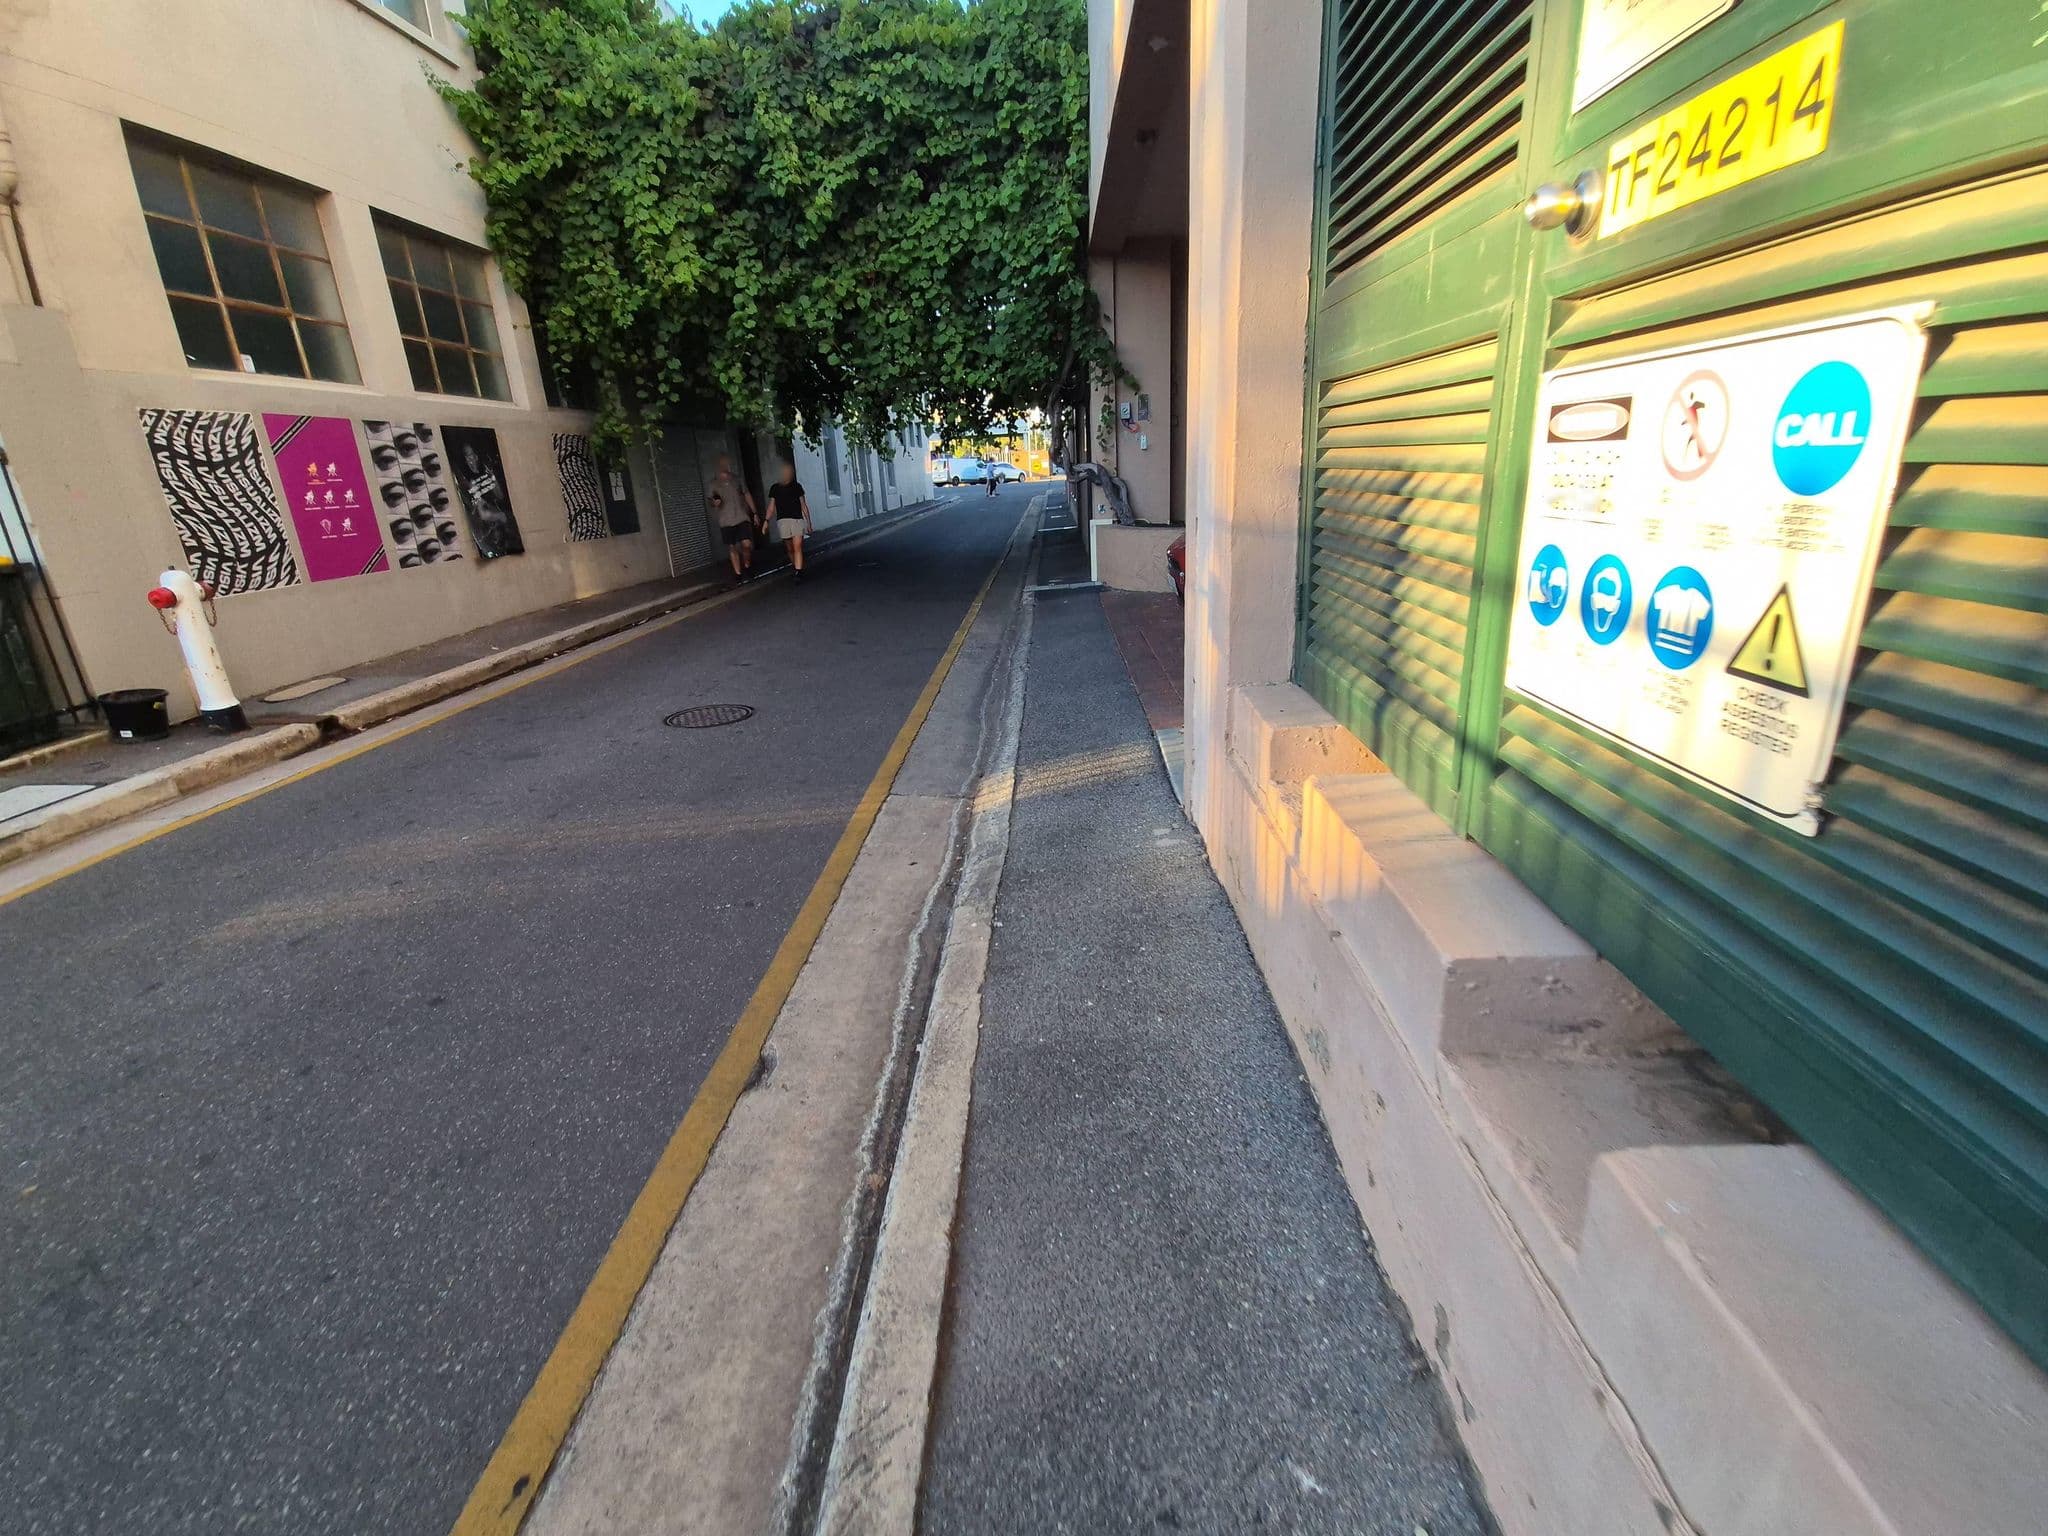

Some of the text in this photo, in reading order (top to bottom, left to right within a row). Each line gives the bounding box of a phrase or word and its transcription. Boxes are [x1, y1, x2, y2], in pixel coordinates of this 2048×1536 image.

[1610, 55, 1826, 216] TF24214
[1775, 410, 1865, 448] CALL
[197, 466, 267, 553] VISUALIZM
[215, 466, 278, 545] VISUALIZM
